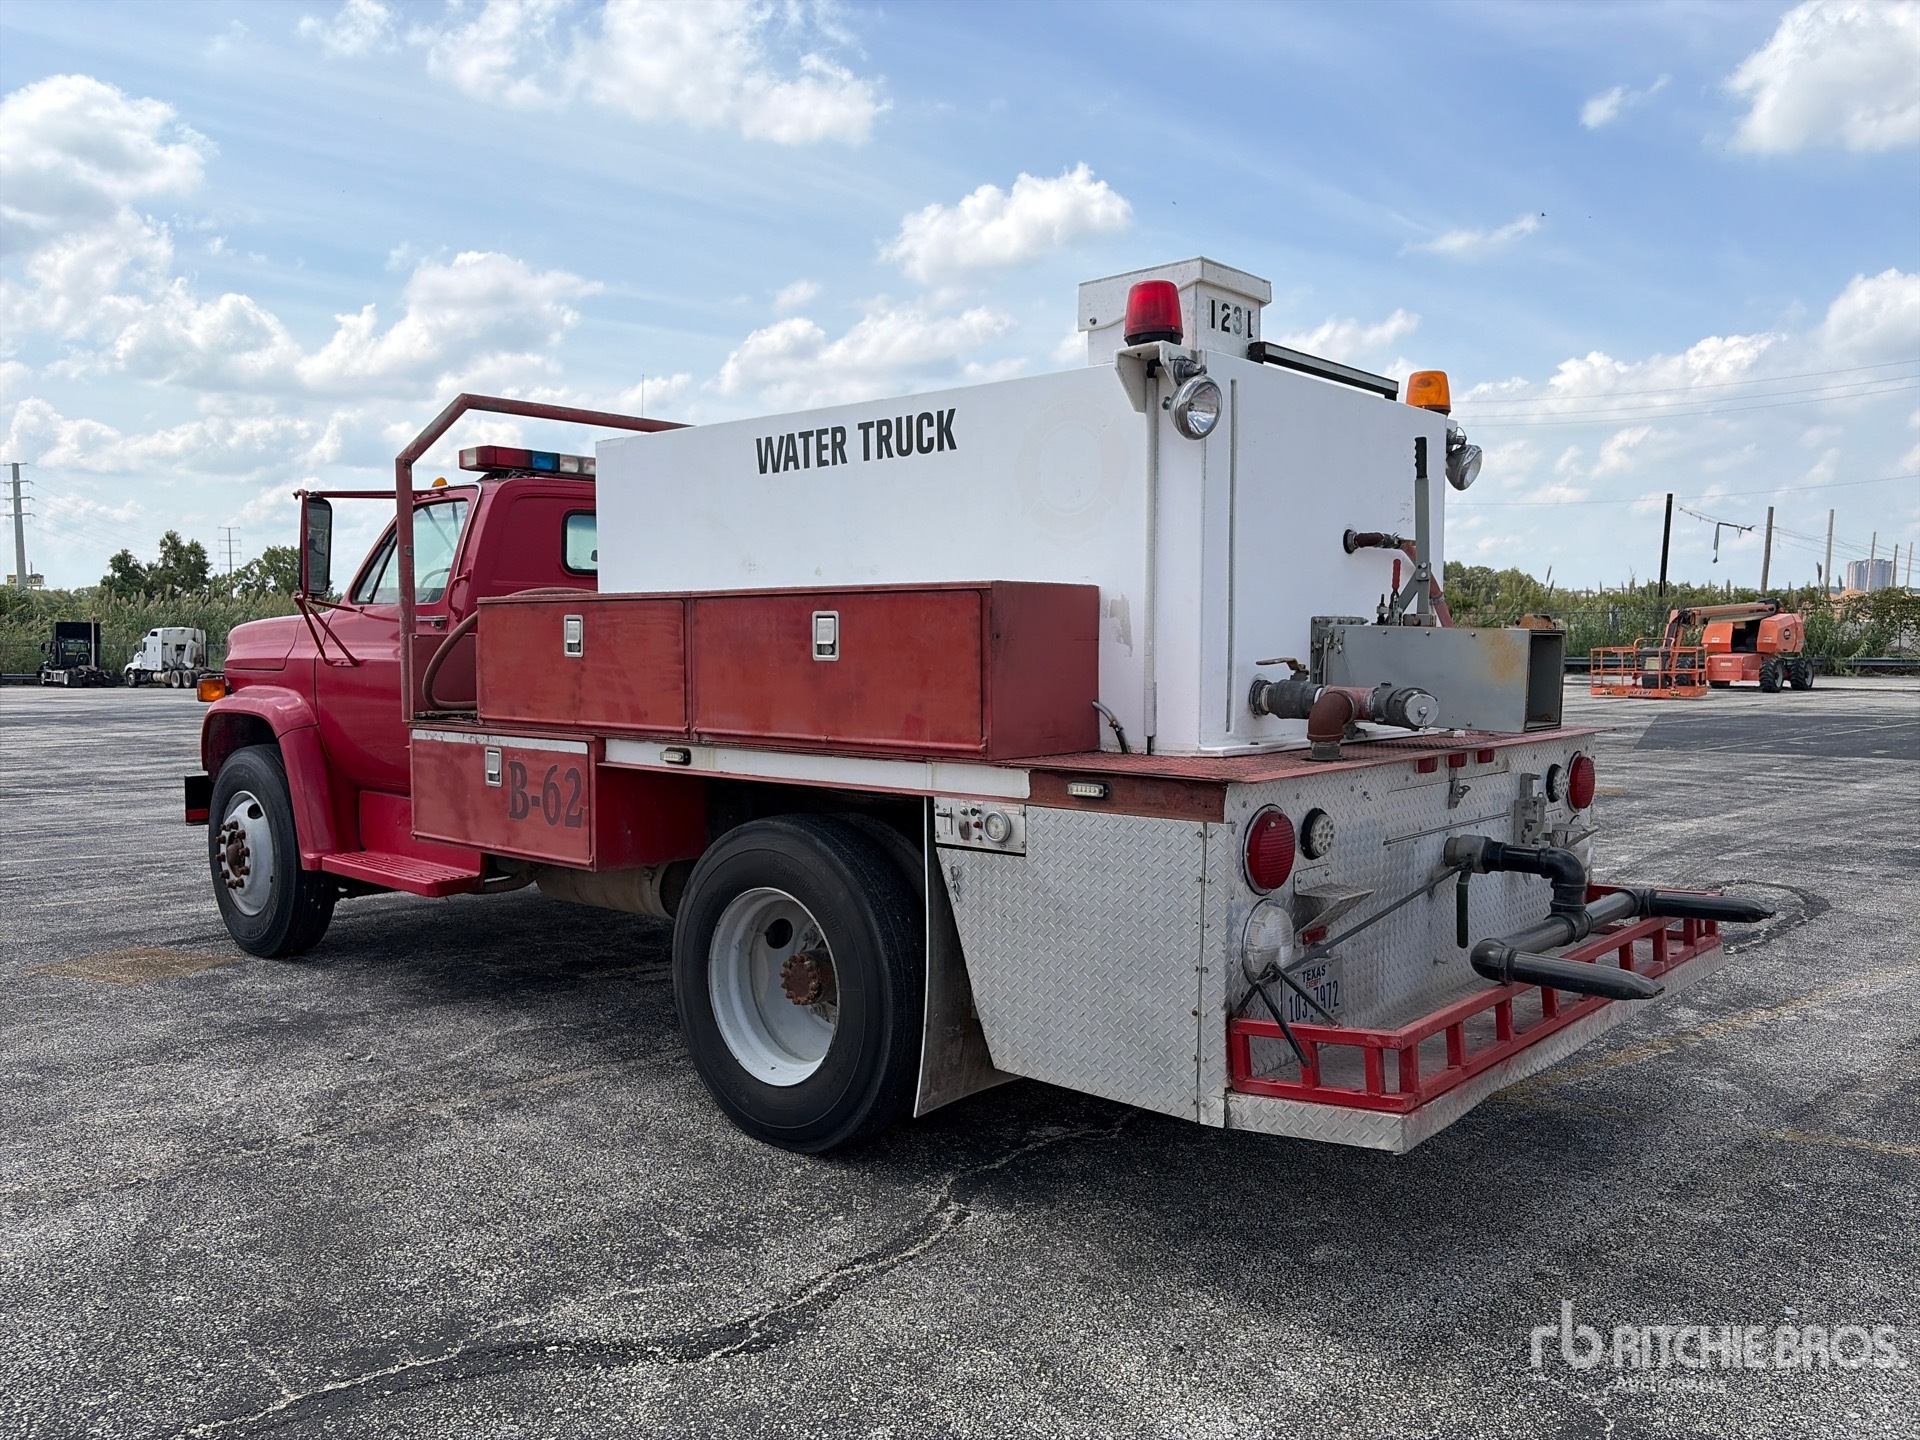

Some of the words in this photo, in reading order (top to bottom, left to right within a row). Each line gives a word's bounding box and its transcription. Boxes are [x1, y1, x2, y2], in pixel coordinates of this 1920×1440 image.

[755, 425, 848, 475] WATER
[857, 408, 958, 462] TRUCK
[508, 760, 584, 829] B-62
[1302, 965, 1326, 983] TEXAS
